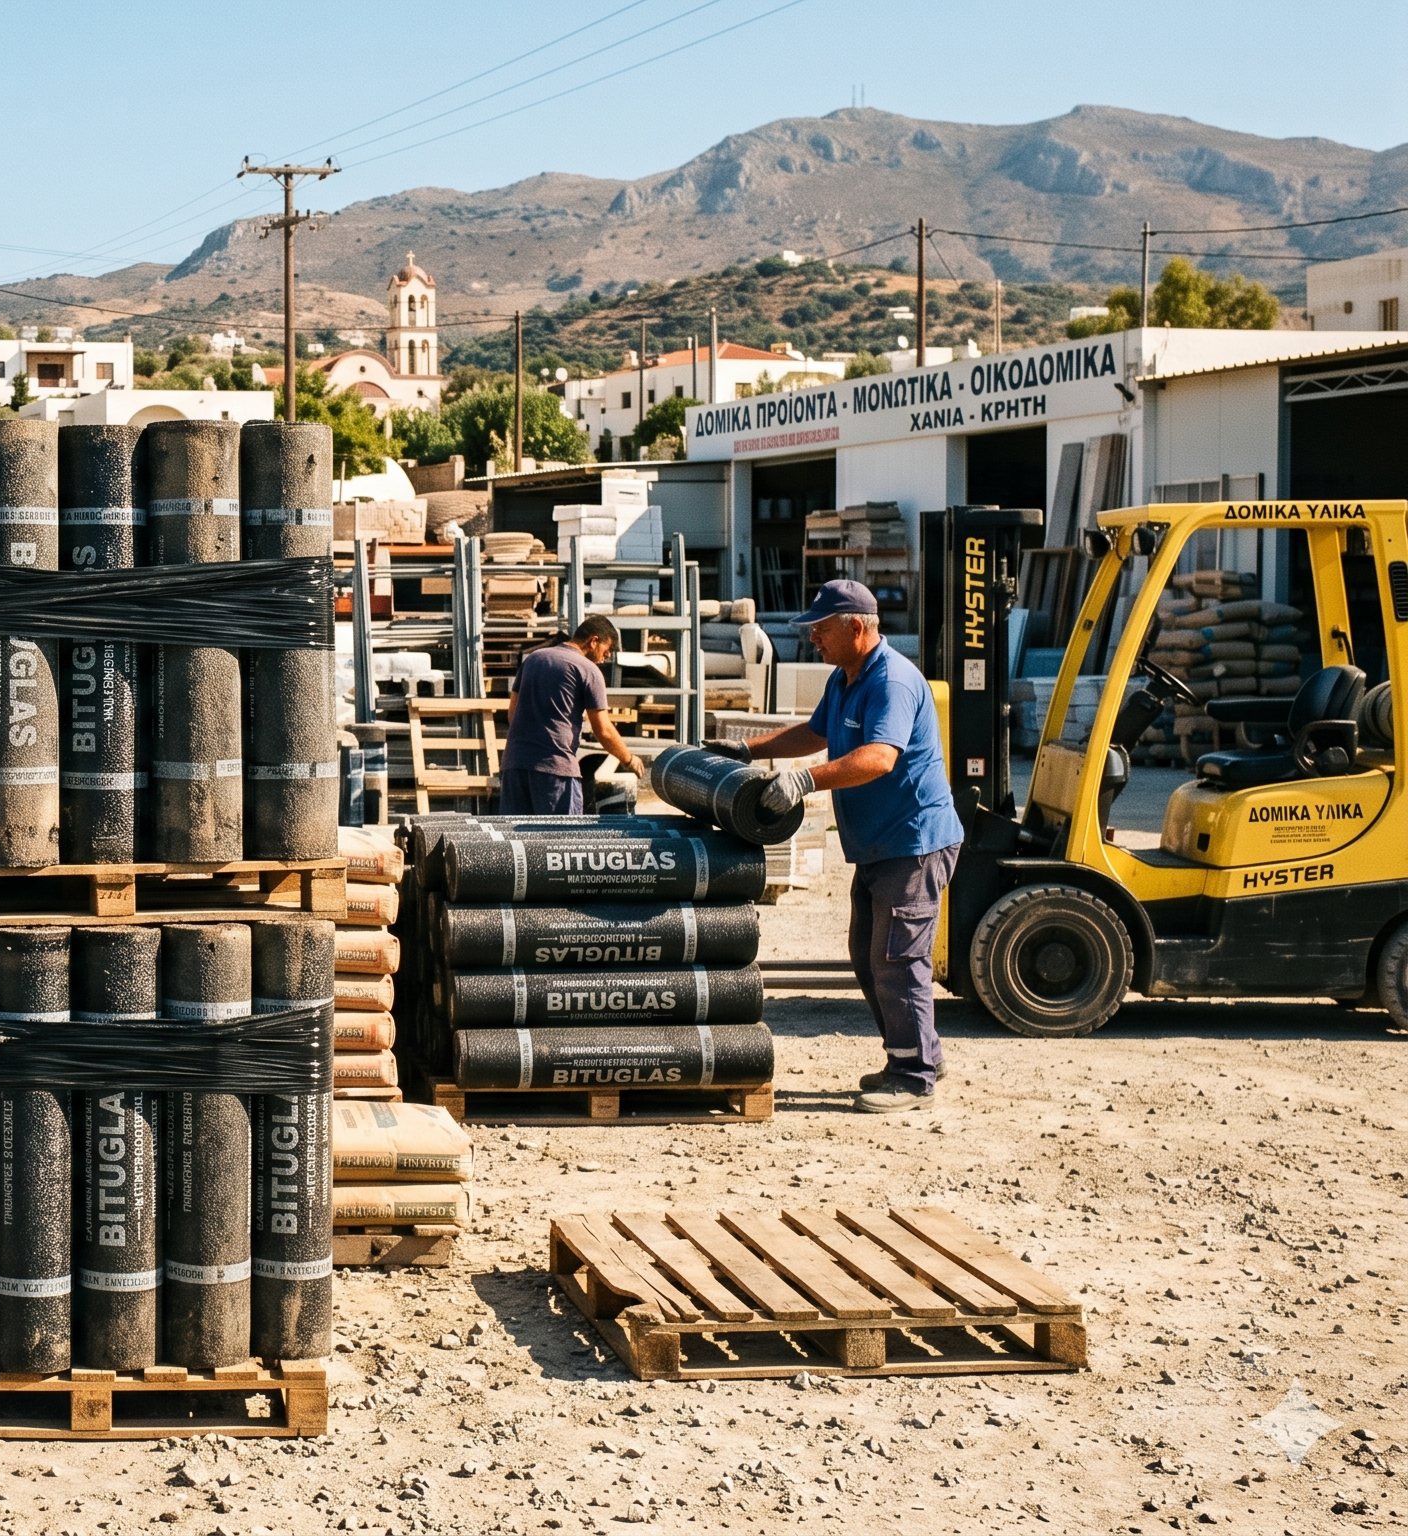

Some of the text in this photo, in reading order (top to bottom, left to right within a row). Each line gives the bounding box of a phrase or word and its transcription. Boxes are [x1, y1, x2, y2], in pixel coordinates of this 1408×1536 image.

[695, 405, 751, 437] ΔΟΜΙΚΑ
[853, 371, 953, 415] ΜΟΝΩΤΙΚΑ
[970, 343, 1117, 396] ΟΙΚΟΔΟΜΙΚΑ
[910, 407, 965, 432] ΧΑΝΙΑ
[981, 394, 1047, 422] ΚΡΗΤΗ
[1224, 504, 1366, 519] ΔΟΜΙΚΑ ΥΛΙΚΑ
[965, 536, 986, 649] HYSTER
[1248, 803, 1364, 822] ΔΟΜΙΚΑ ΥΛΙΚΑ
[546, 851, 676, 871] BITUGLAS
[1243, 864, 1334, 889] HYSTER
[535, 946, 662, 963] BITUGLAS
[547, 991, 677, 1011] BITUGLAS
[553, 1067, 682, 1084] BITUGLAS
[99, 1091, 126, 1247] BITUGLA
[271, 1094, 299, 1235] BITUGL
